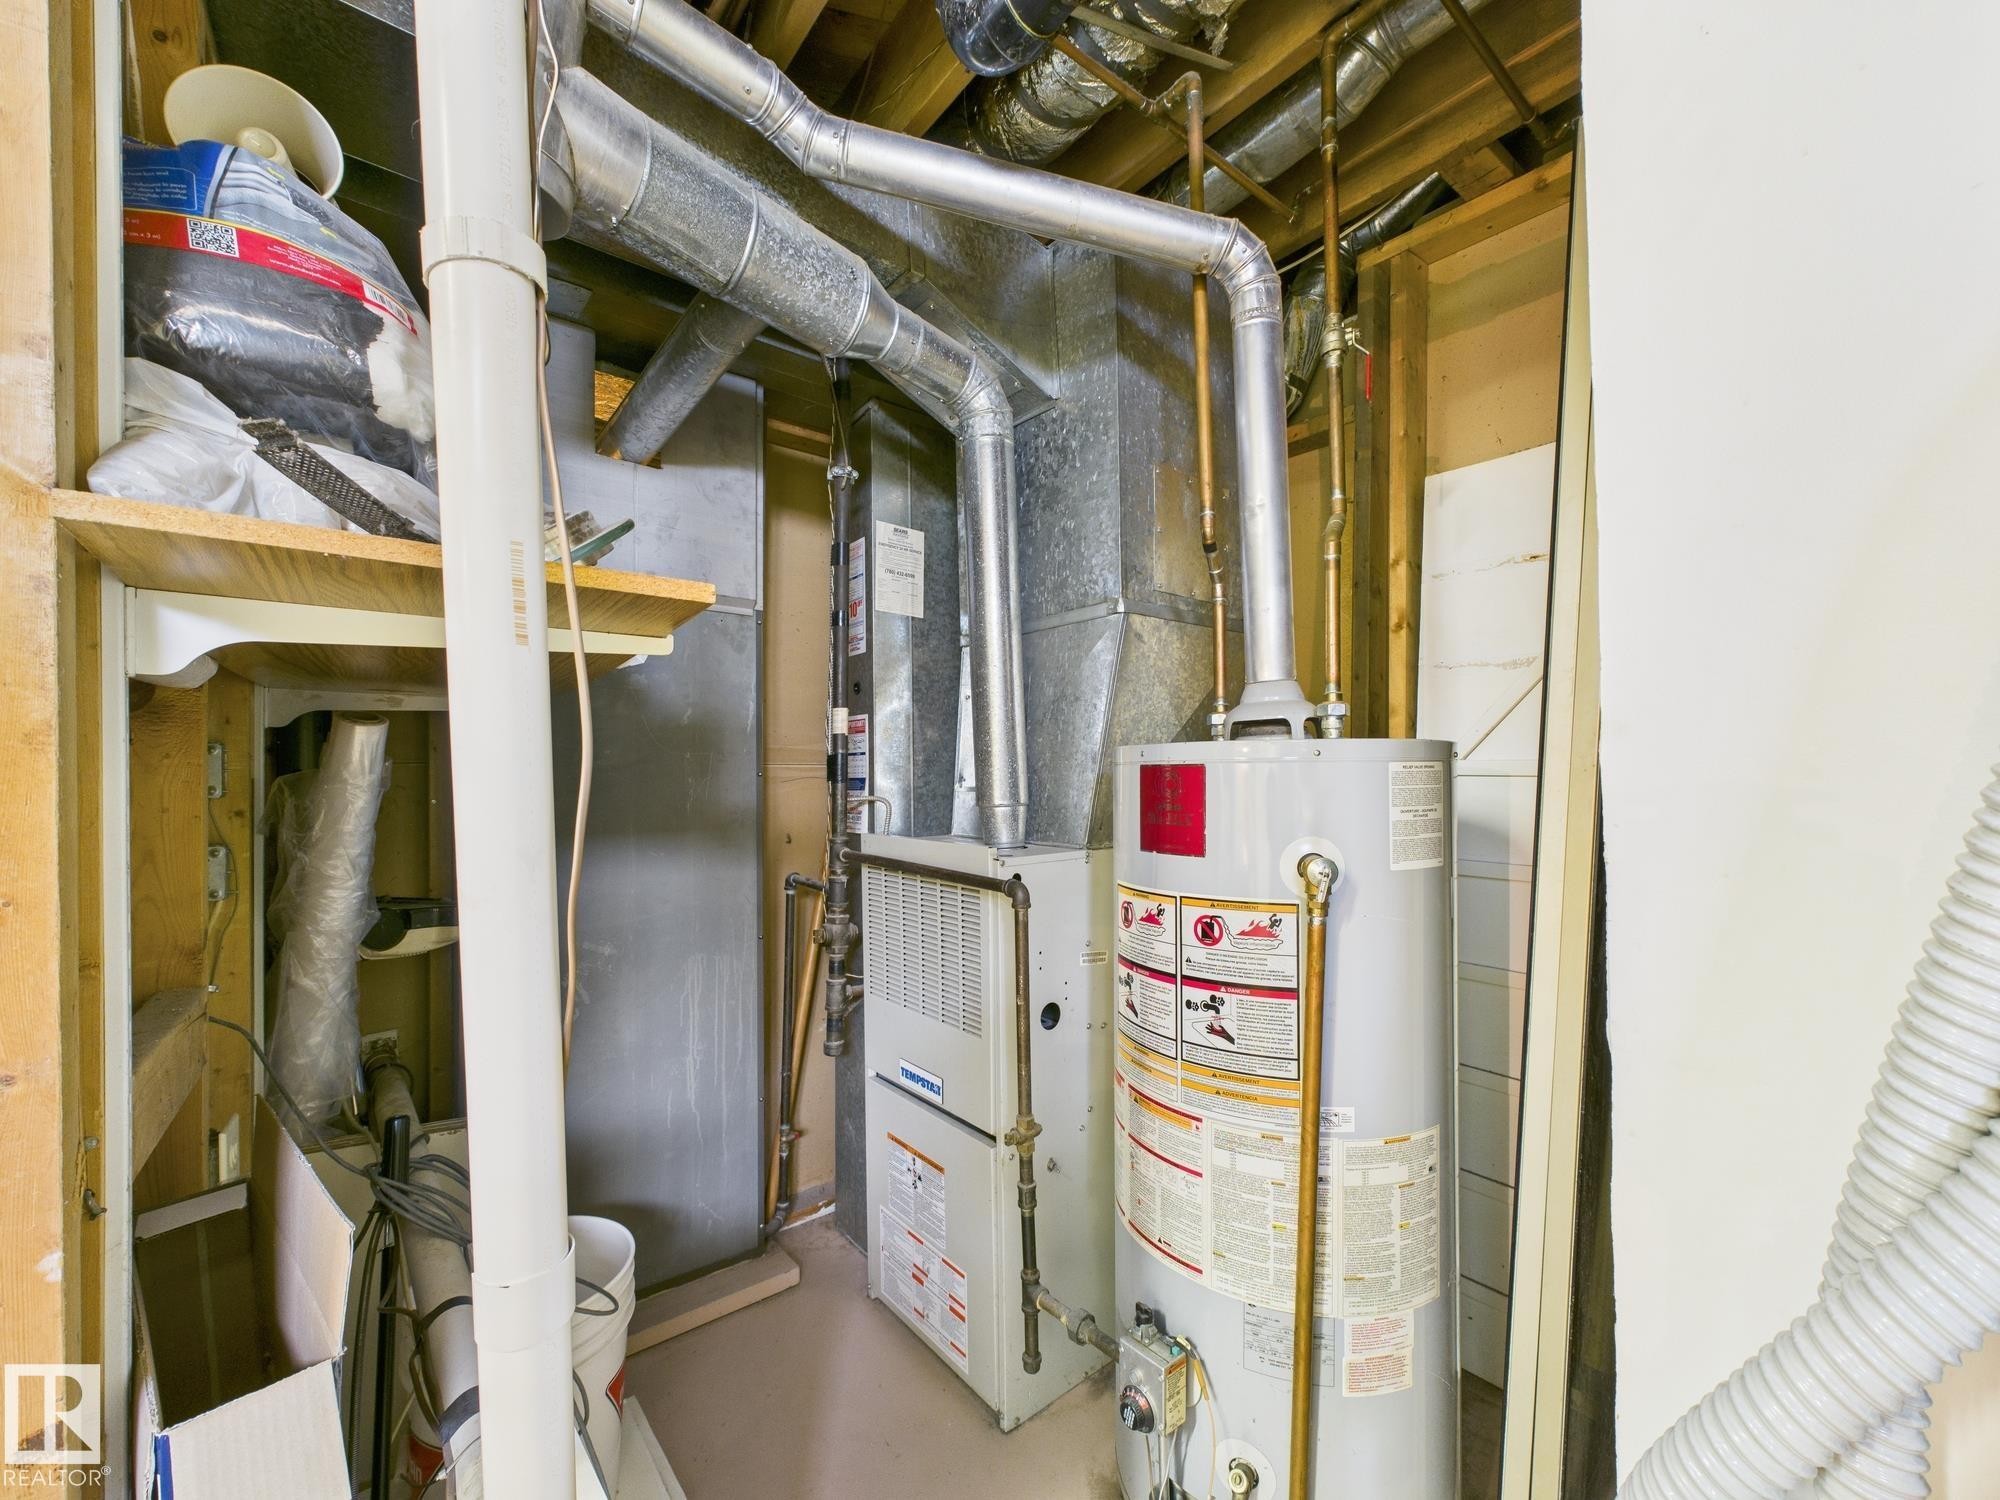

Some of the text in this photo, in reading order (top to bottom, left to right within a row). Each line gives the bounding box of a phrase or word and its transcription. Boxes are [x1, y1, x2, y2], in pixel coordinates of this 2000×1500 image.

[900, 1066, 941, 1096] TEMPSTAR
[1218, 1073, 1260, 1085] AVERTISSEMENT
[1222, 1090, 1258, 1102] ADVERTENCIA
